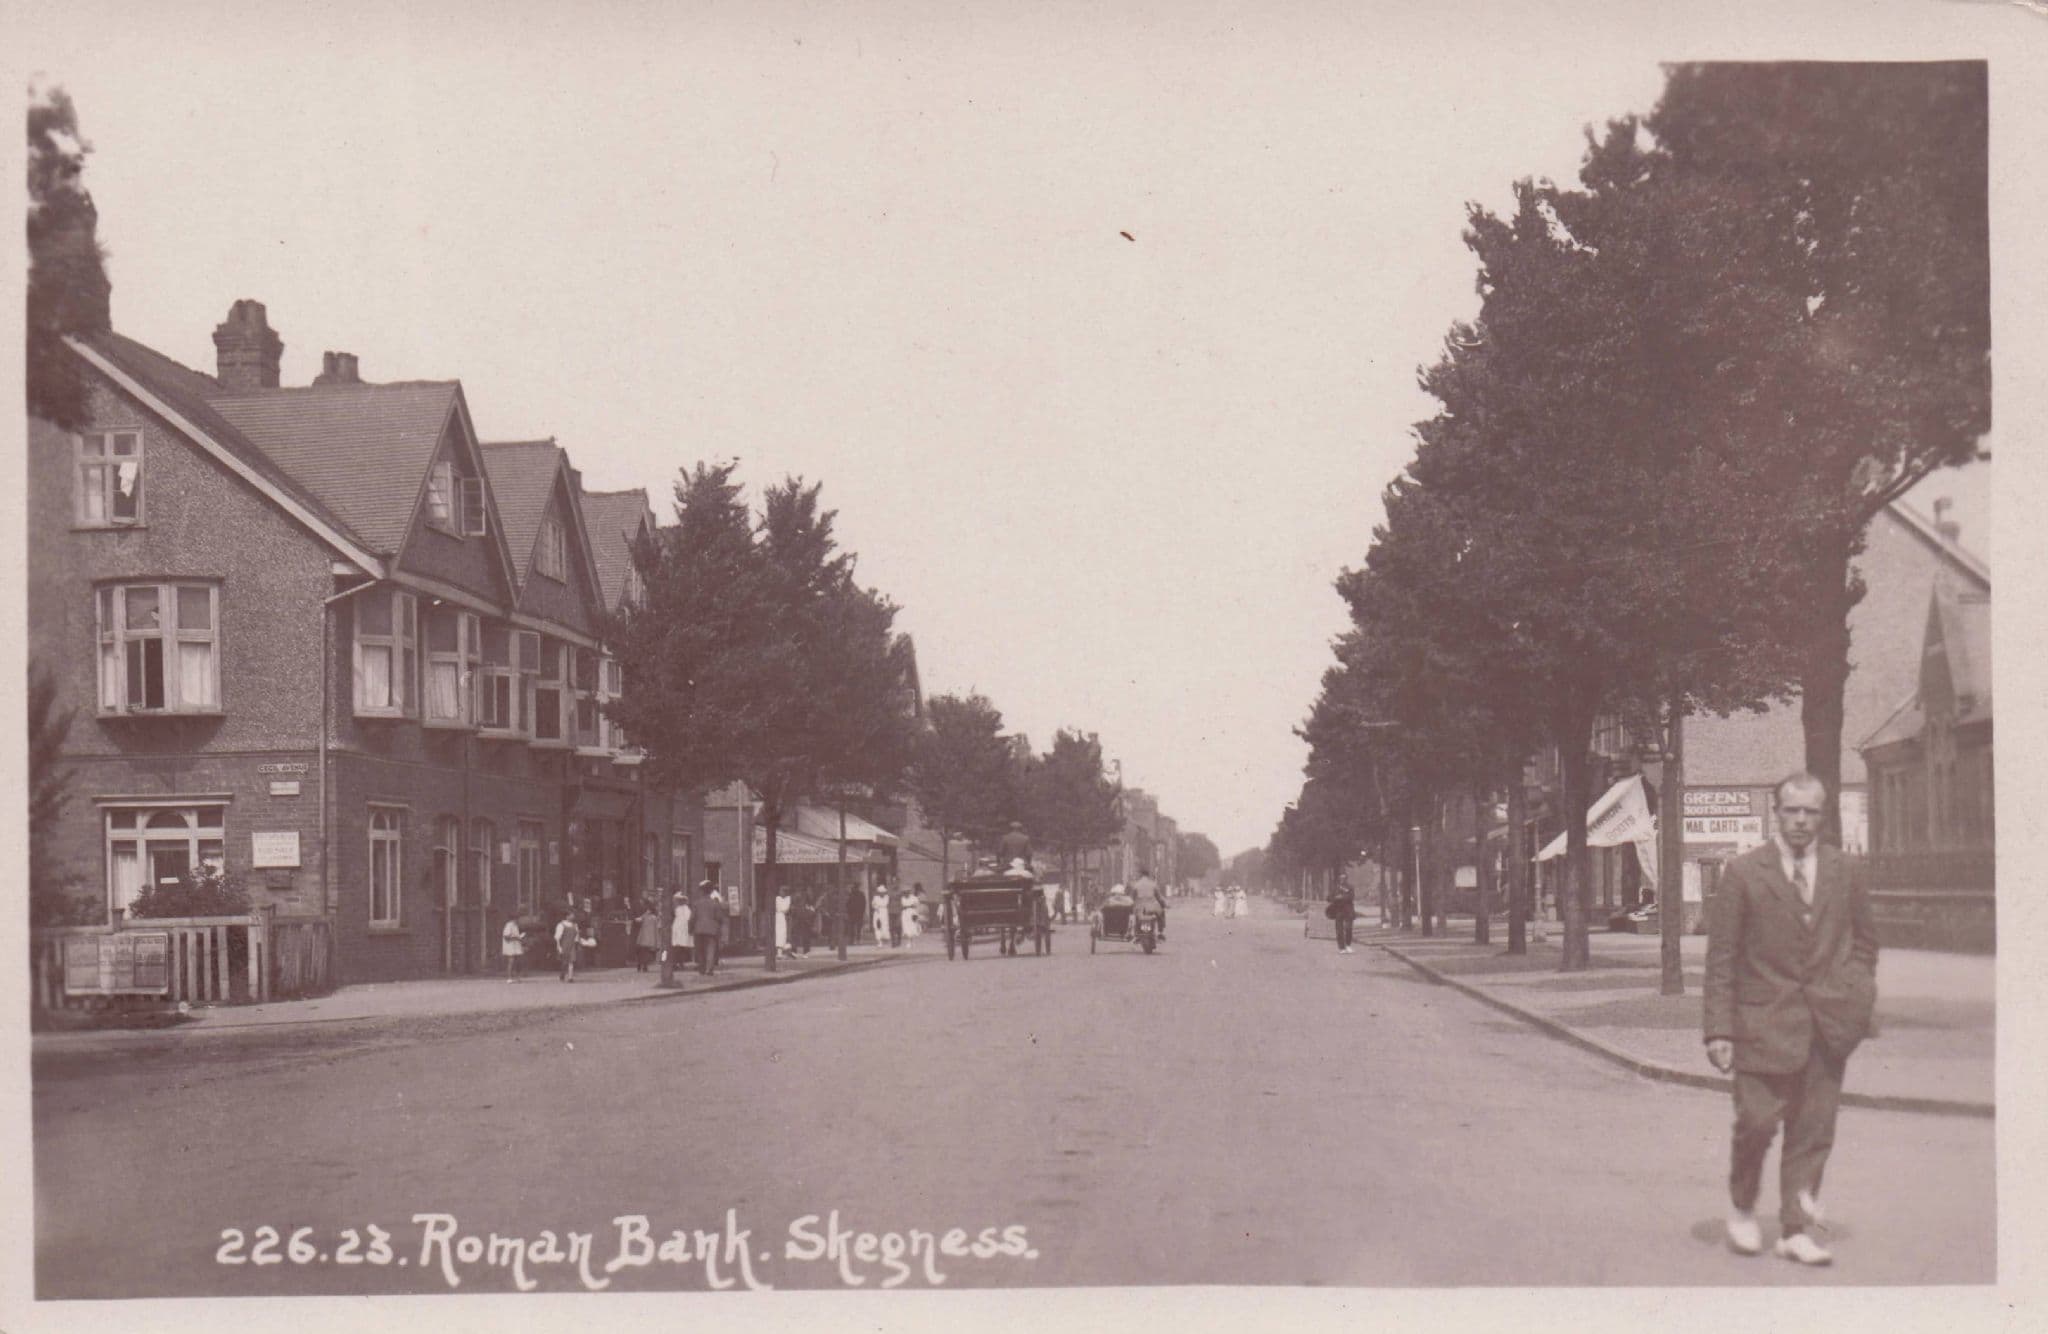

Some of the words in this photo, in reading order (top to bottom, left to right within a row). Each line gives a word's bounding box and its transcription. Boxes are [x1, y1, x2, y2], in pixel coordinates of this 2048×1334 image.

[259, 765, 275, 773] CECIL
[281, 763, 306, 772] AVENUE
[1683, 791, 1750, 805] GREEN'S
[1685, 820, 1705, 833] MAIL
[1710, 820, 1739, 832] CARTS
